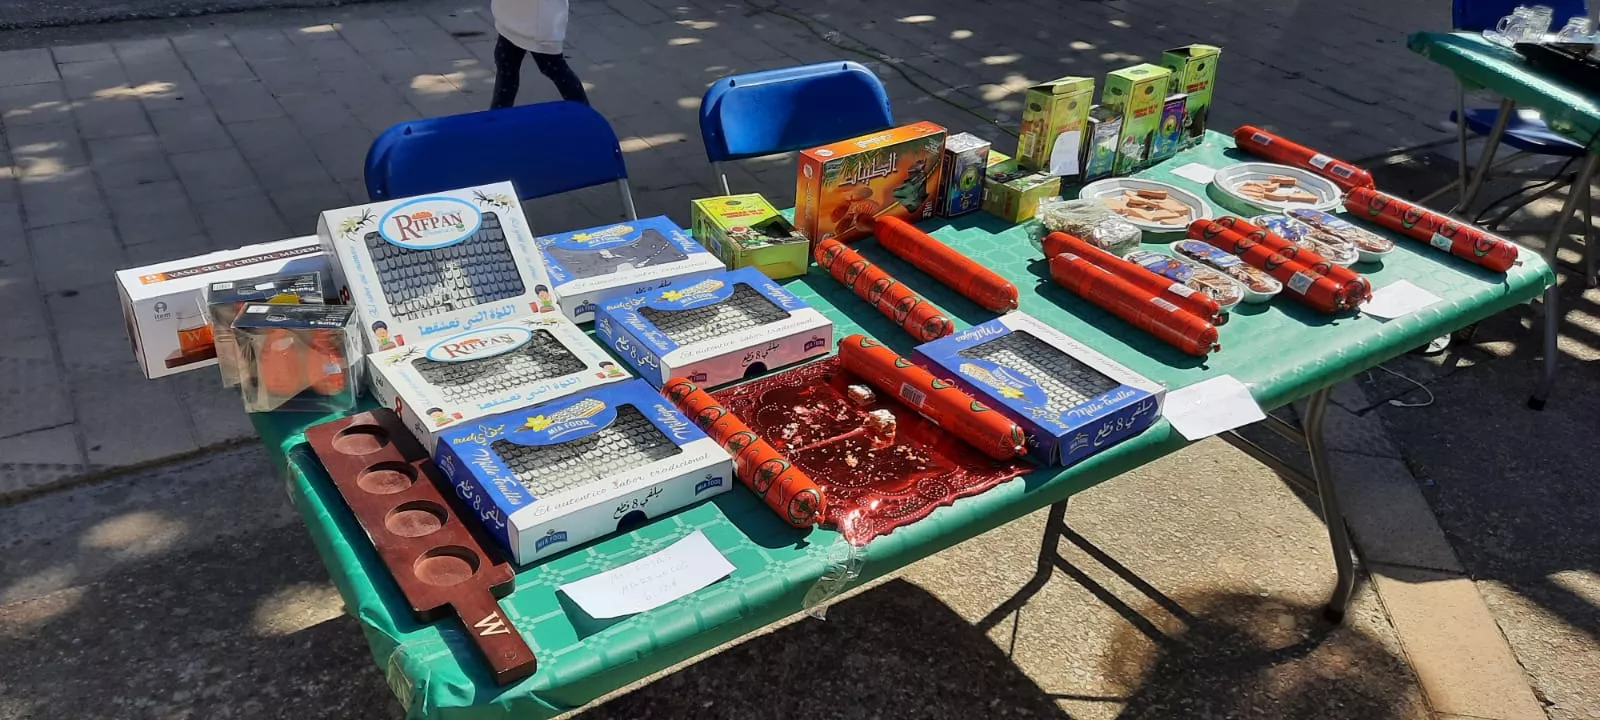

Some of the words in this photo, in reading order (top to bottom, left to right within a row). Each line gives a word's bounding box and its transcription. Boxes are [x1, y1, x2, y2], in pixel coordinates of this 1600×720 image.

[838, 151, 897, 187] الطيبات
[392, 212, 463, 241] RIFPAN
[169, 267, 199, 279] VASO
[202, 264, 222, 273] SET
[234, 254, 278, 267] CRISTAL
[280, 245, 322, 259] MADERA
[441, 333, 513, 358] RIFPAN
[548, 424, 564, 435] MIA
[564, 419, 591, 430] FOOD
[1115, 417, 1123, 432] 8
[473, 495, 481, 511] 8
[632, 498, 639, 509] 8
[473, 610, 511, 636] W
